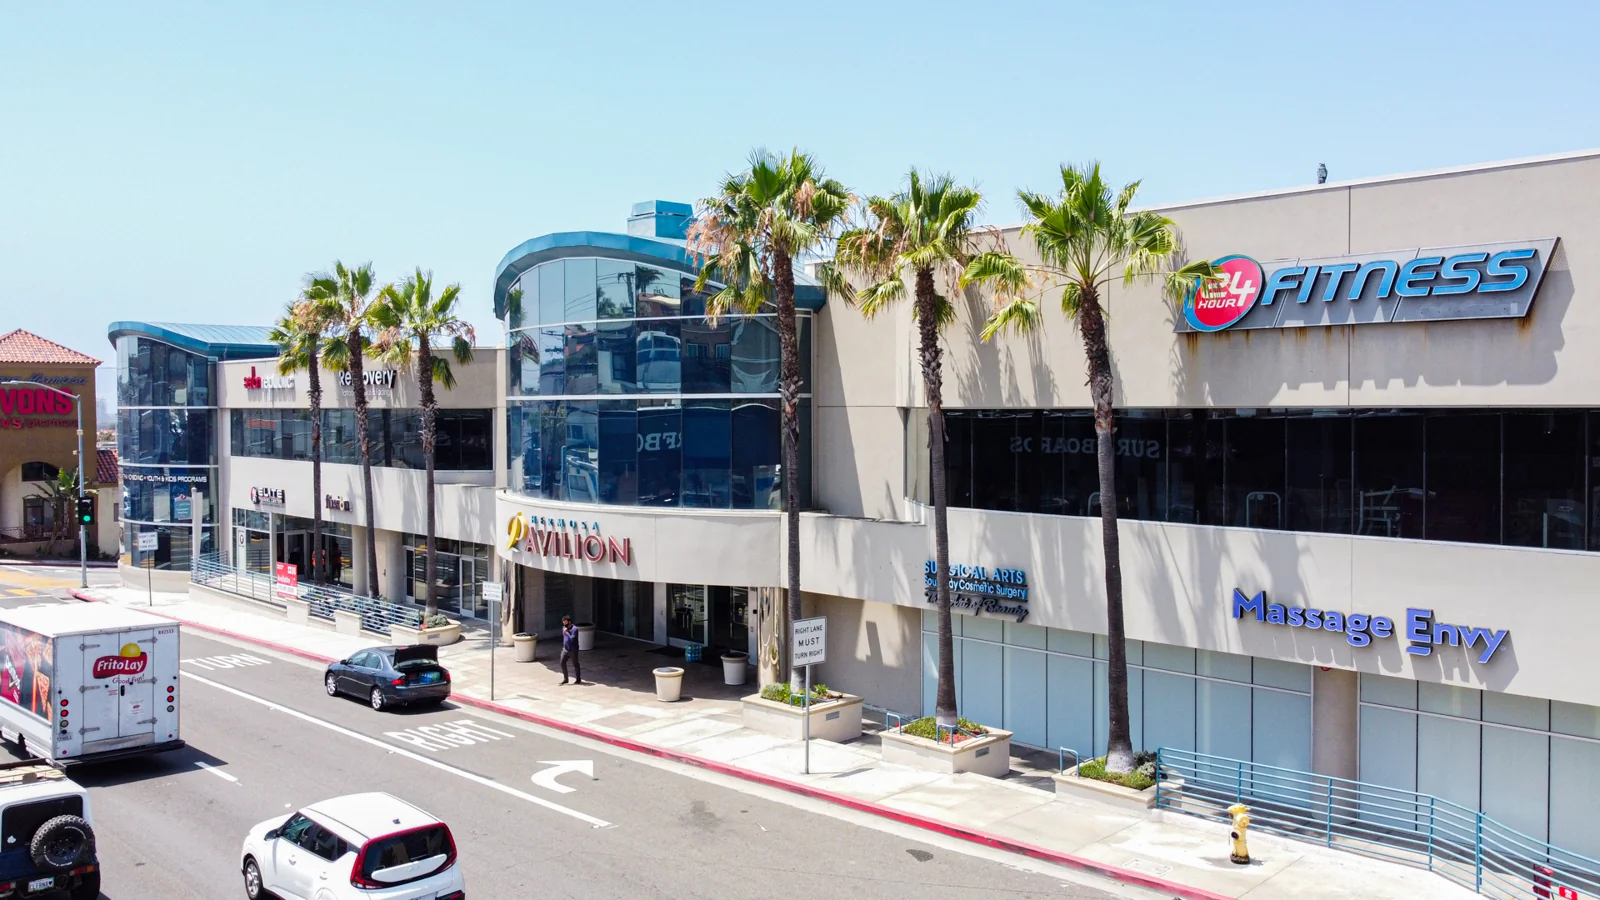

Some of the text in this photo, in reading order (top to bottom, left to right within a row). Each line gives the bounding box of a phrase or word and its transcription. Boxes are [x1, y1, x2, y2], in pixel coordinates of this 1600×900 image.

[1260, 248, 1536, 306] FITNESS
[1201, 271, 1256, 306] 24
[1197, 298, 1236, 309] HOUR
[339, 370, 395, 388] Reovery
[0, 387, 73, 415] VONS
[177, 475, 207, 483] PROGRAMS
[258, 487, 283, 498] ELITE
[531, 515, 600, 531] HERMOSA
[924, 560, 1026, 585] SUGICAL ARTS
[959, 579, 994, 593] Cosmetic
[996, 585, 1028, 599] Surgery
[924, 589, 939, 604] Th
[983, 598, 1030, 623] Beauty
[795, 626, 809, 635] RIGHT
[1232, 587, 1510, 664] Massage Envy
[798, 636, 820, 647] MUST
[179, 652, 272, 671] TURN
[809, 649, 823, 658] RIGHT
[383, 719, 515, 752] RIGHT
